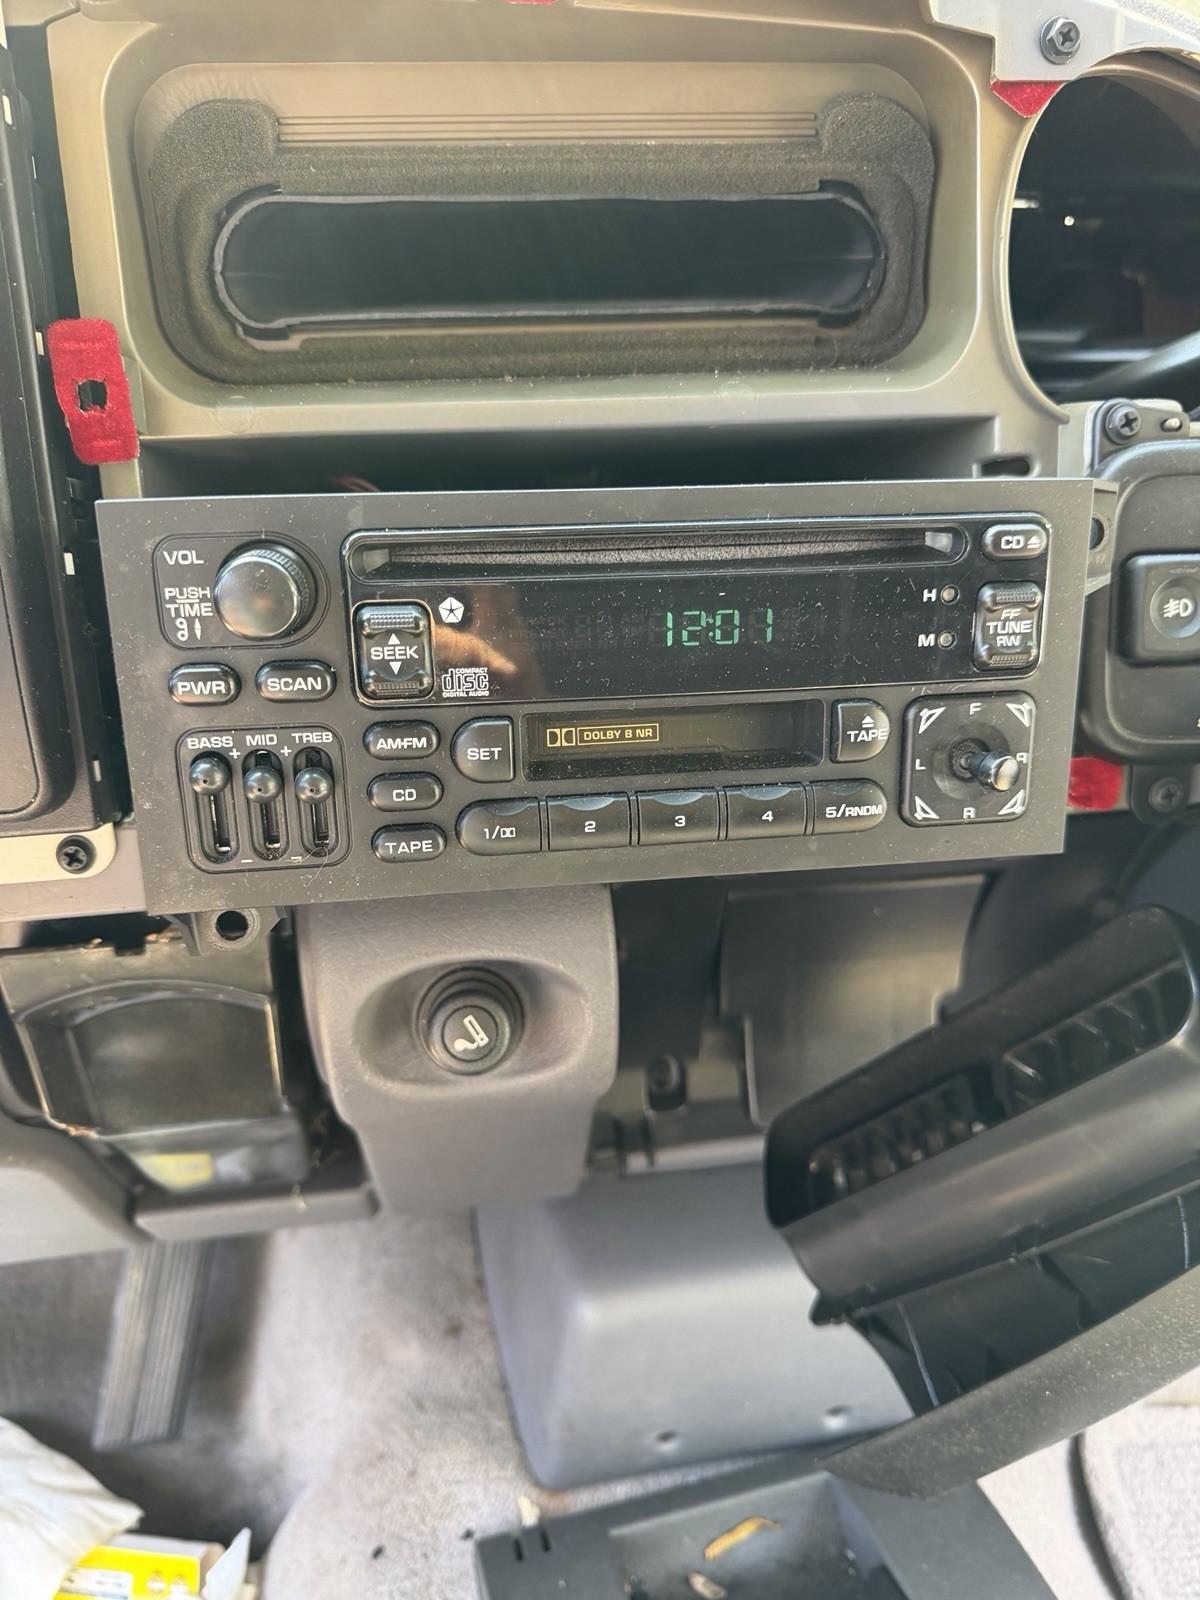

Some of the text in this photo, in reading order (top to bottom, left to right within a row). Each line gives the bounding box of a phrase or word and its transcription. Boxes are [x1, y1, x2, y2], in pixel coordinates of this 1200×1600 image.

[1000, 535, 1025, 550] CD
[163, 549, 205, 566] VOL
[164, 586, 211, 601] PUSH
[922, 588, 938, 603] H
[165, 602, 214, 618] TIME
[1001, 608, 1023, 621] FF
[666, 608, 773, 647] 12:01
[985, 620, 1034, 636] TUNE
[917, 633, 936, 648] M
[996, 635, 1021, 648] RW
[370, 645, 419, 661] SEEK
[455, 667, 488, 675] COMPACT
[177, 680, 227, 696] PWR
[266, 676, 322, 692] SCAN
[969, 702, 982, 715] F
[245, 733, 278, 747] MID
[291, 731, 334, 744] TREB
[583, 728, 653, 741] DOLBY B NR
[847, 727, 889, 743] TAPE
[187, 735, 234, 750] BASS
[466, 747, 503, 761] SET
[915, 758, 927, 771] L
[392, 788, 417, 802] CD
[761, 811, 775, 823] 4
[825, 803, 883, 819] 5/RNDM
[962, 807, 977, 819] R
[584, 821, 597, 833] 2
[674, 815, 687, 828] 3
[384, 839, 434, 855] TAPE
